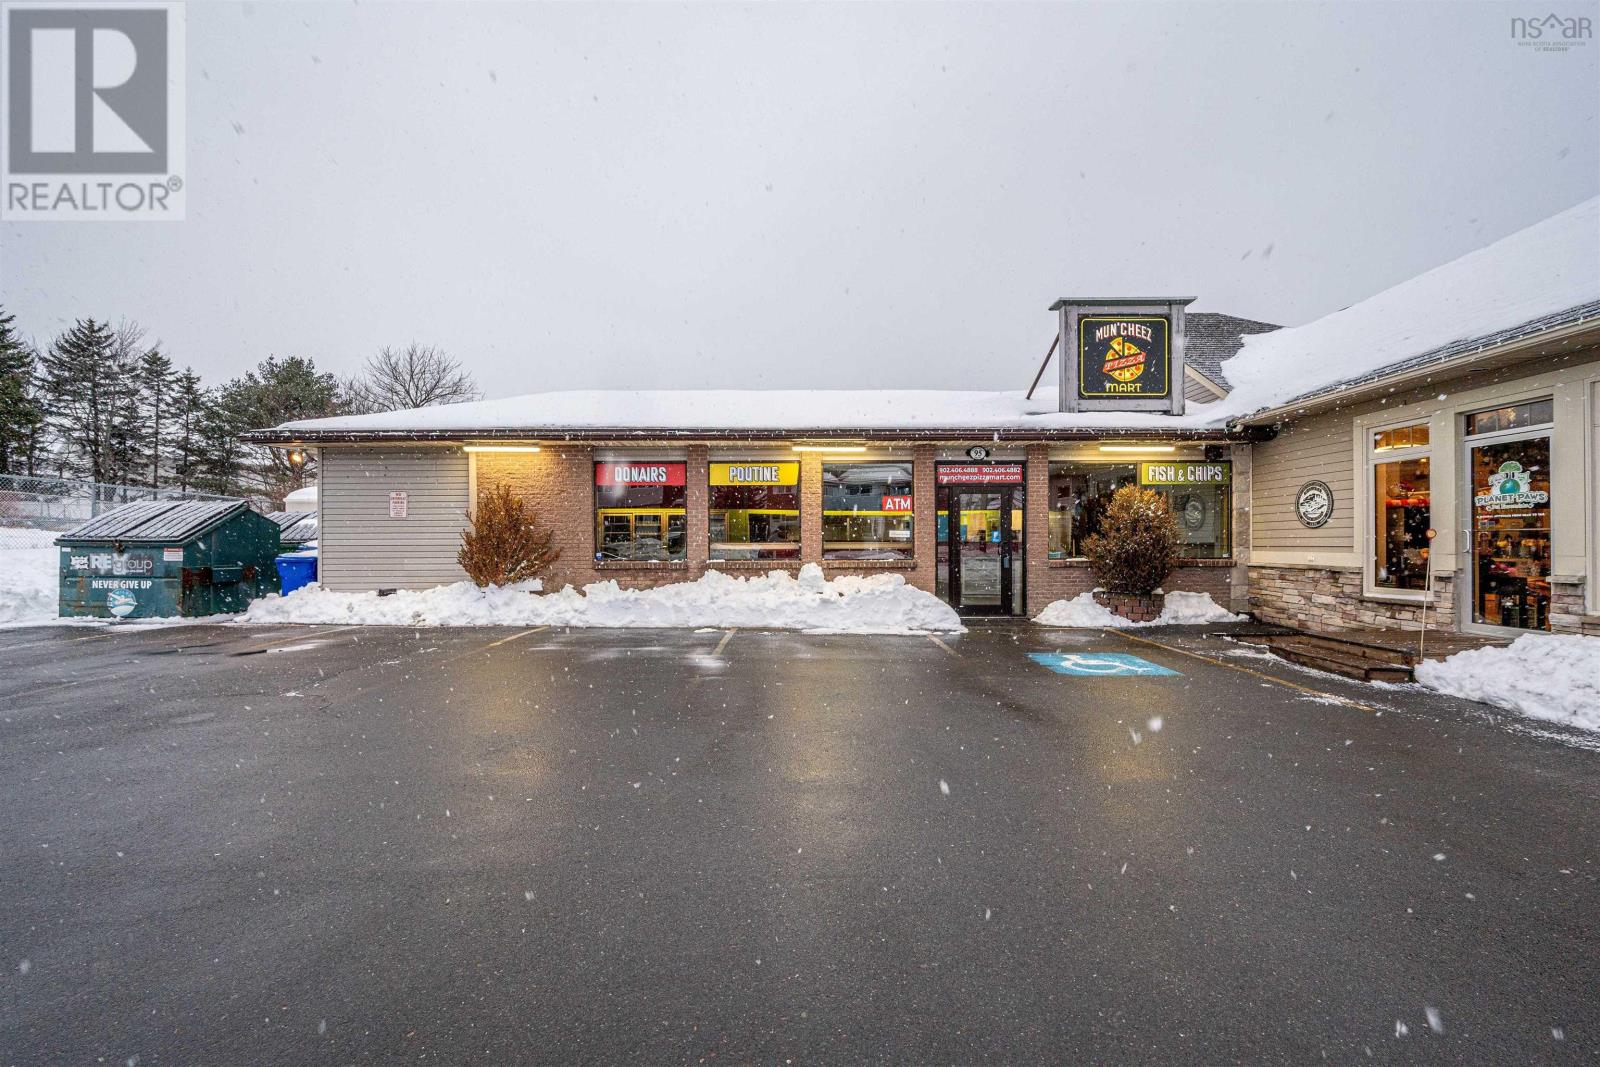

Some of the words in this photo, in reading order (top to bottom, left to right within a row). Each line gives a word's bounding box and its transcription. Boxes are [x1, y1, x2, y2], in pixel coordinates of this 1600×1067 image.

[1105, 355, 1145, 370] PIZZA
[1106, 383, 1142, 393] MART
[974, 449, 983, 457] 95
[614, 466, 667, 482] DONAIRS
[729, 466, 779, 482] POUTINE
[1148, 466, 1175, 482] FISH
[1177, 469, 1185, 482] &
[1187, 465, 1223, 482] CHIPS
[885, 498, 910, 510] ATM
[1477, 494, 1513, 504] PLANET
[1517, 493, 1546, 503] PAWS
[92, 580, 119, 589] NEVER
[120, 580, 139, 589] GIVE
[140, 580, 152, 589] UP
